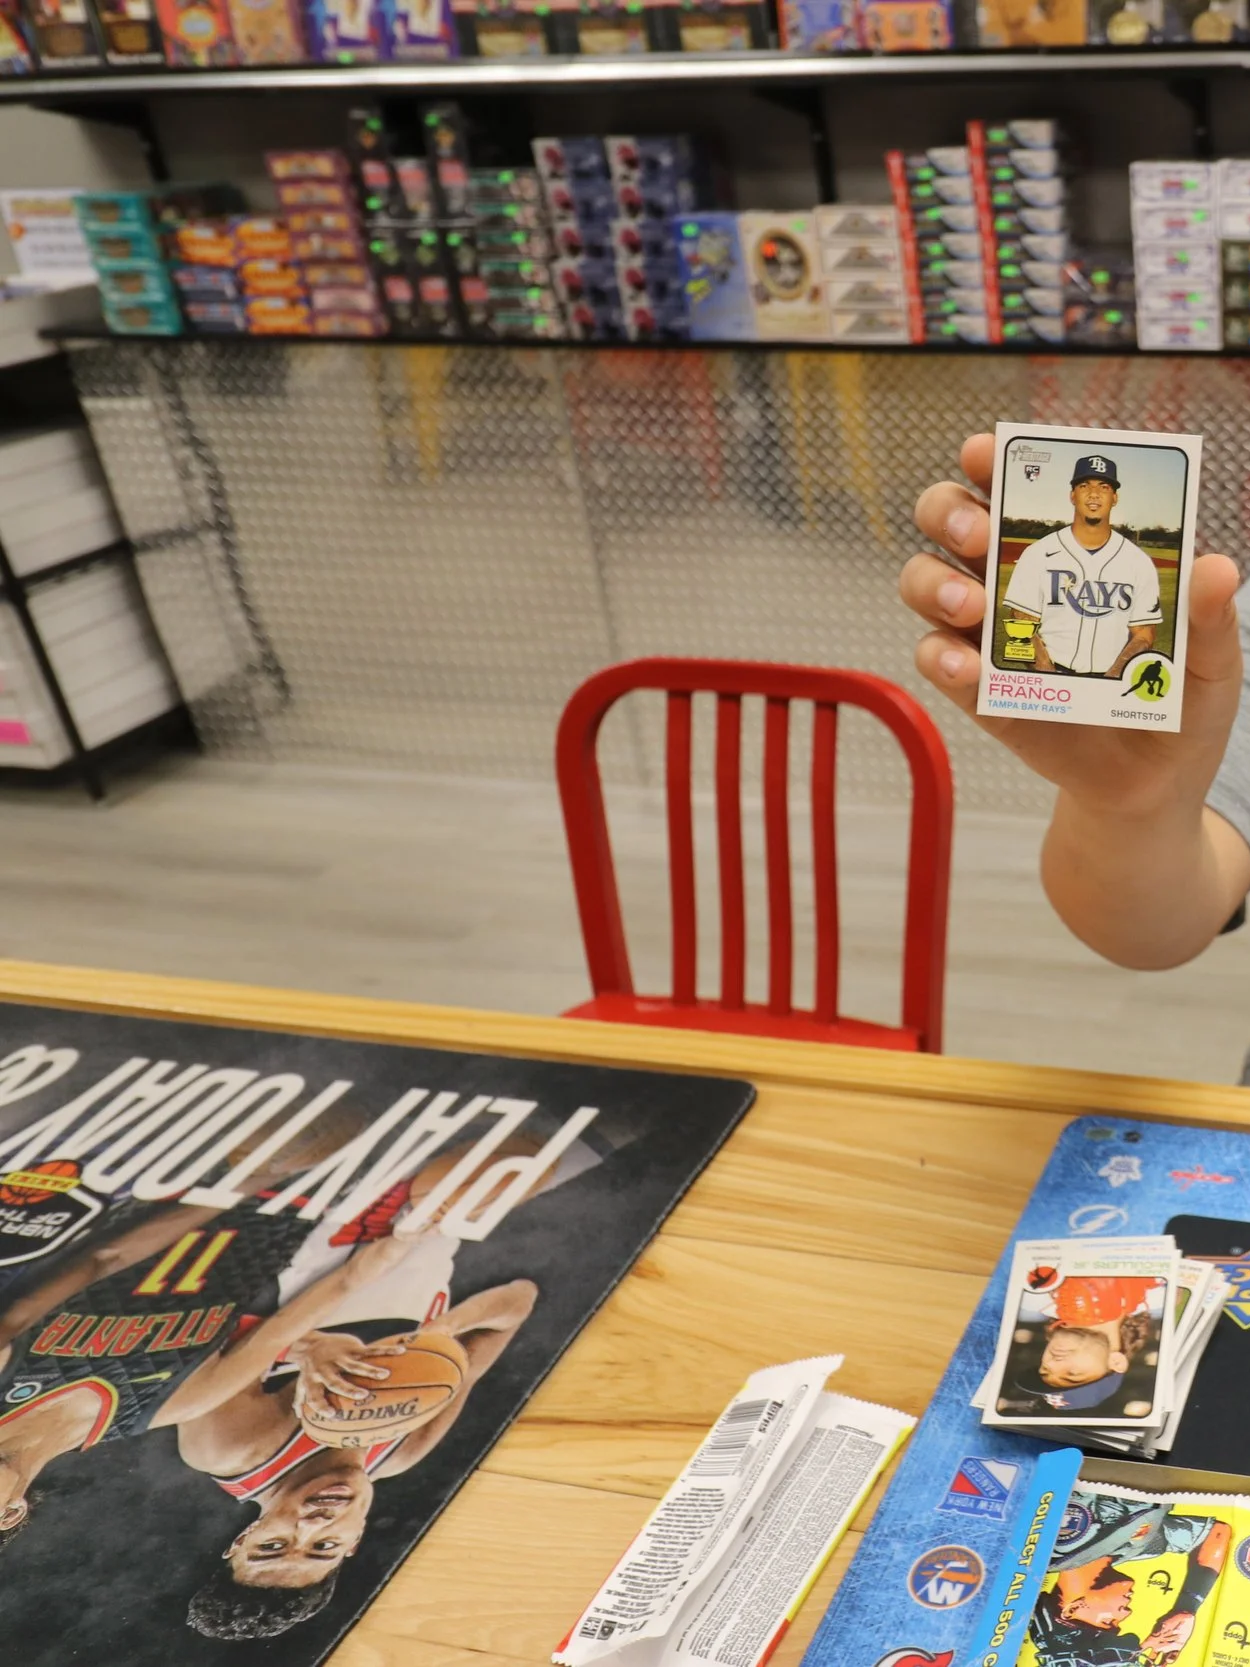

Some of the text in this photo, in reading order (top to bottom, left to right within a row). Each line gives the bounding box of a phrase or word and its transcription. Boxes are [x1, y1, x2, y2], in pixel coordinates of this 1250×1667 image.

[988, 683, 1071, 703] FRANCO
[989, 673, 1043, 686] WANDER
[988, 699, 1018, 709] TAMPA
[1020, 703, 1040, 711] BAY
[1110, 709, 1167, 722] SHORTSTOP
[256, 1087, 600, 1242] PLAY
[132, 1229, 238, 1295] 11
[30, 1302, 237, 1357] ATLANTA
[962, 1461, 1000, 1498] RANGERS
[977, 1501, 1001, 1513] NEW
[1018, 1491, 1054, 1567] COLLECT
[1003, 1572, 1027, 1606] ALL
[989, 1609, 1015, 1648] 500
